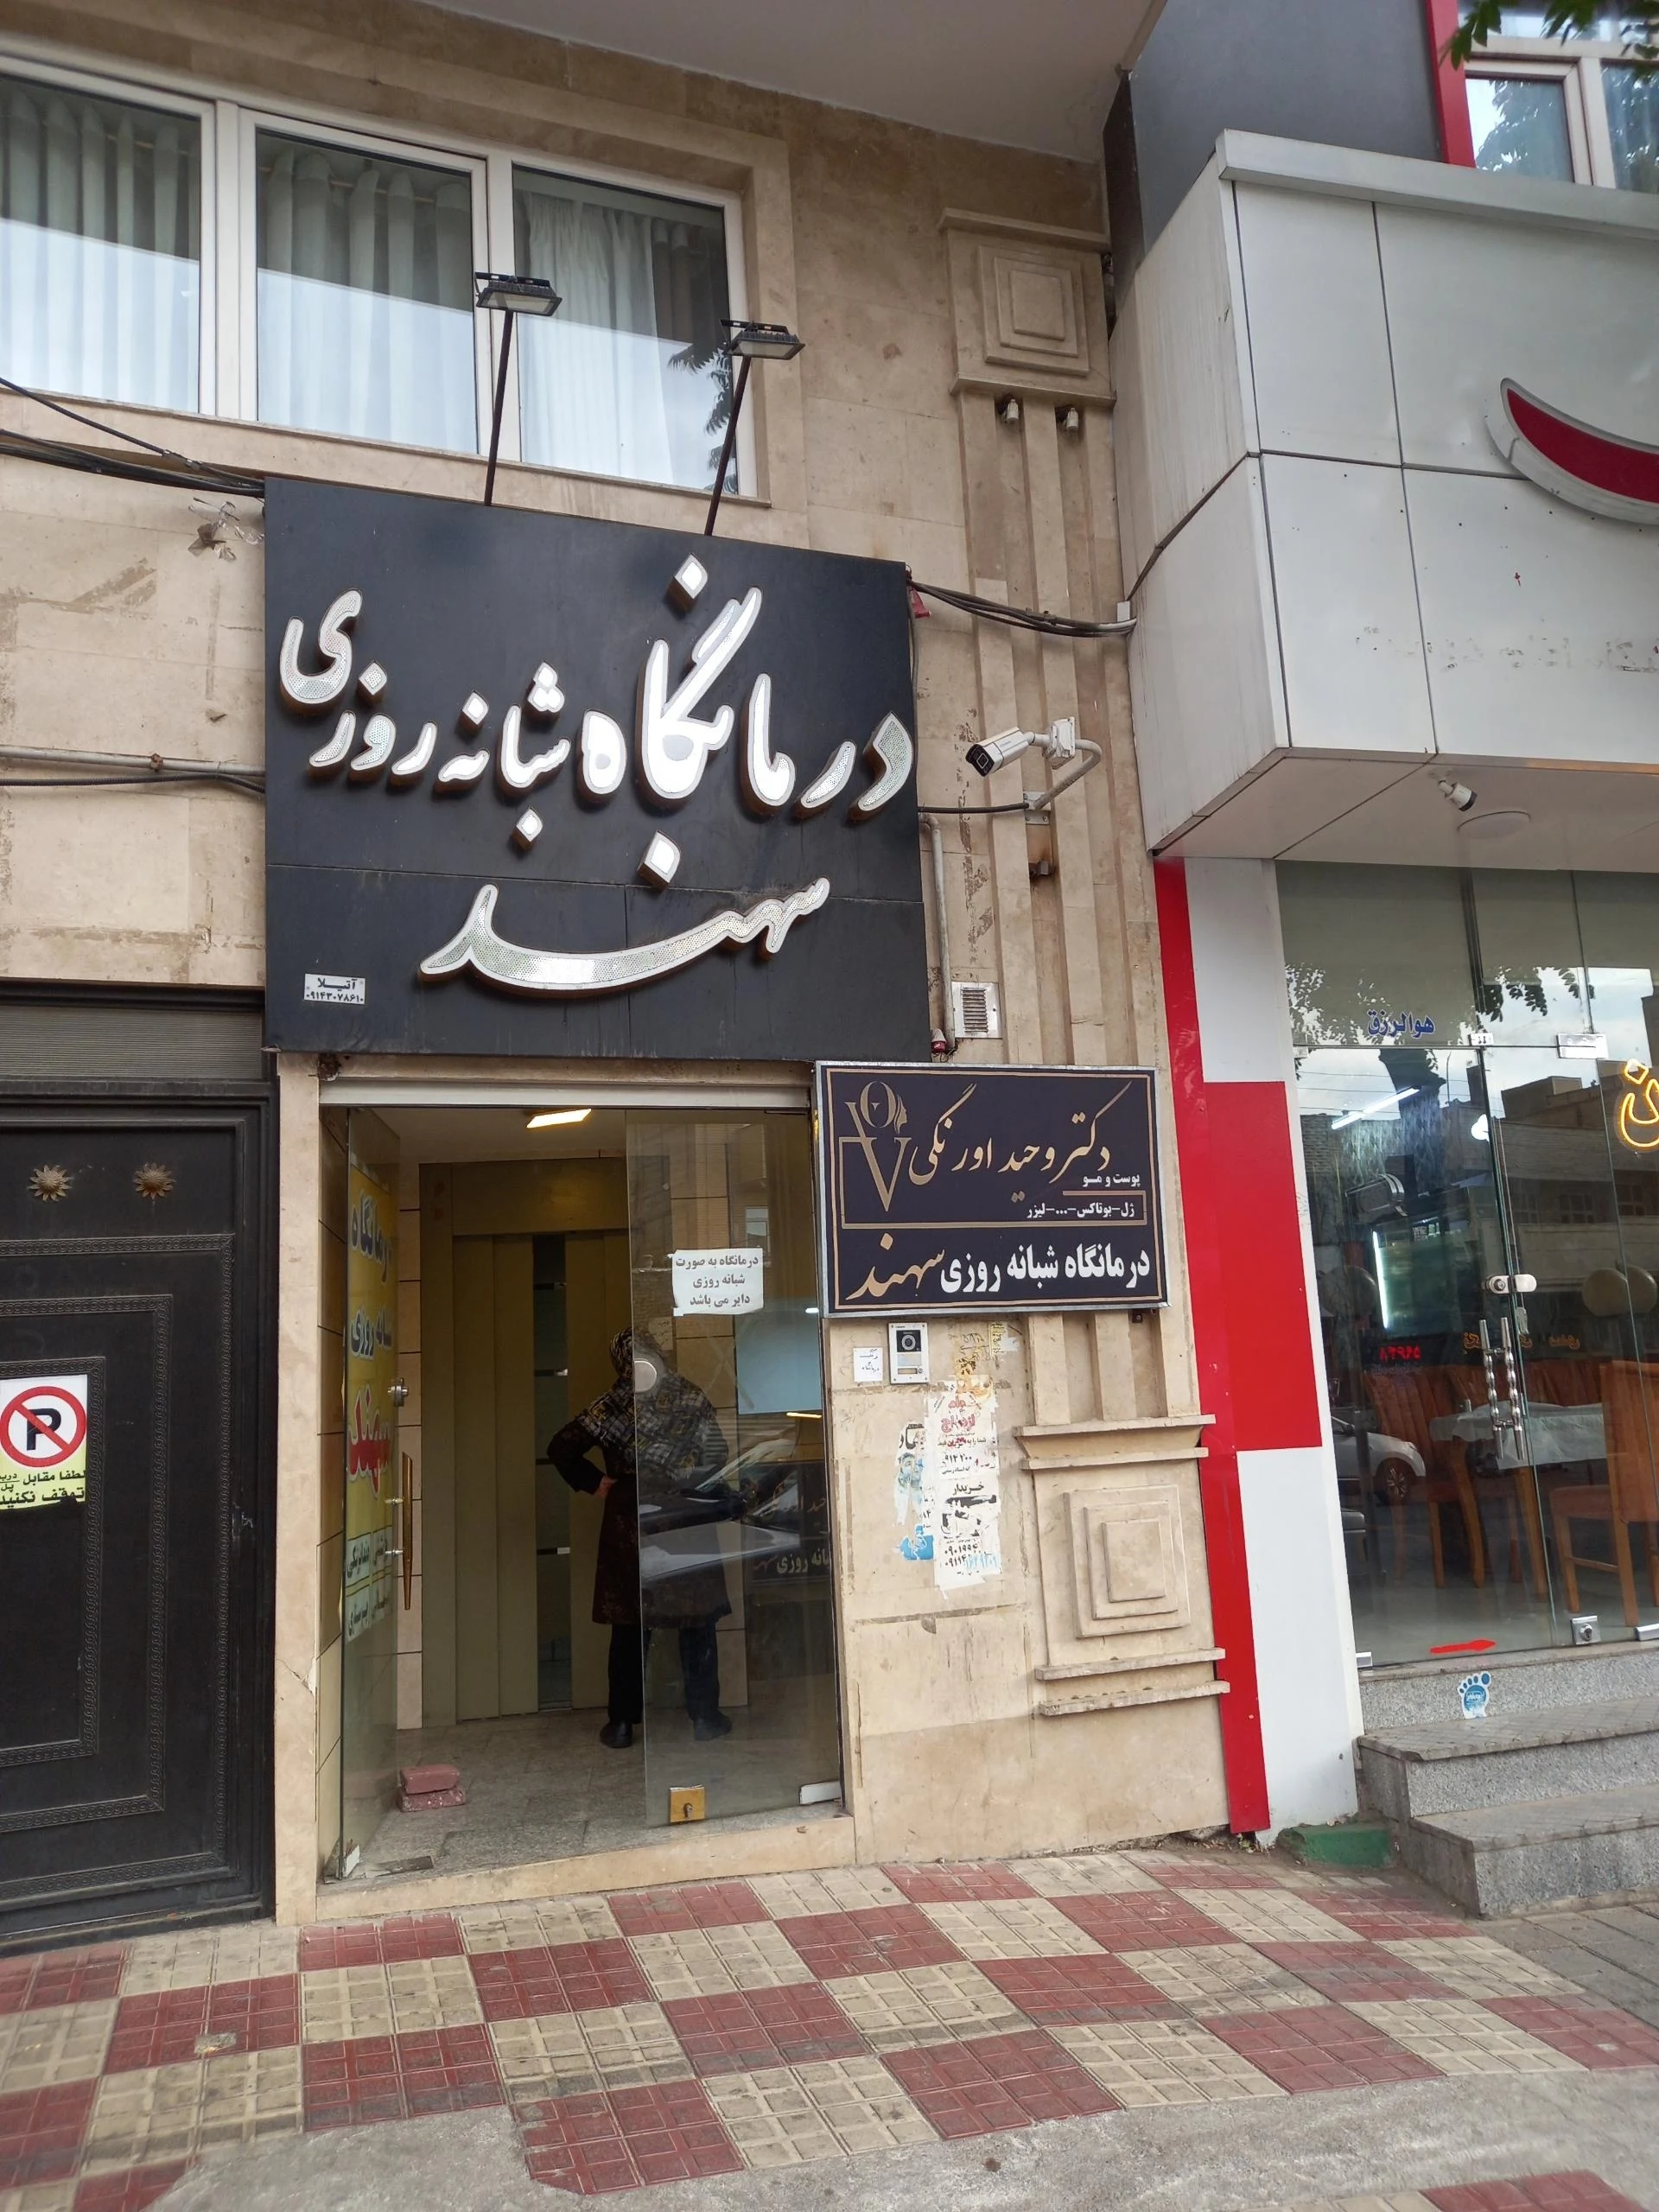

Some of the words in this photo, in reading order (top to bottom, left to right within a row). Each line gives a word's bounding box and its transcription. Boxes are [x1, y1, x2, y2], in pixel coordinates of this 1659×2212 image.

[279, 588, 438, 782] روزی
[577, 551, 914, 817] درمانگاه
[434, 660, 571, 847] شبانه
[317, 977, 358, 992] آتیلا
[1048, 1081, 1132, 1184] دکتر
[998, 1144, 1056, 1203] وحید
[1104, 1175, 1111, 1185] و
[1112, 1173, 1141, 1187] پوست
[676, 1257, 705, 1270] صورت
[708, 1258, 717, 1268] به
[719, 1255, 759, 1268] درمانگاه
[846, 1233, 945, 1300] سهند
[1006, 1243, 1058, 1288] شبانه
[1065, 1243, 1150, 1288] درمانگاه
[721, 1273, 746, 1287] شبانه
[940, 1253, 1001, 1293] روزی
[693, 1276, 720, 1288] روزی
[690, 1295, 711, 1307] باشد
[714, 1299, 729, 1307] می
[731, 1294, 750, 1307] دایر
[23, 1471, 55, 1486] مقابل
[60, 1470, 86, 1480] لطفا
[1, 1484, 14, 1493] پل
[952, 1481, 984, 1496] خریدار
